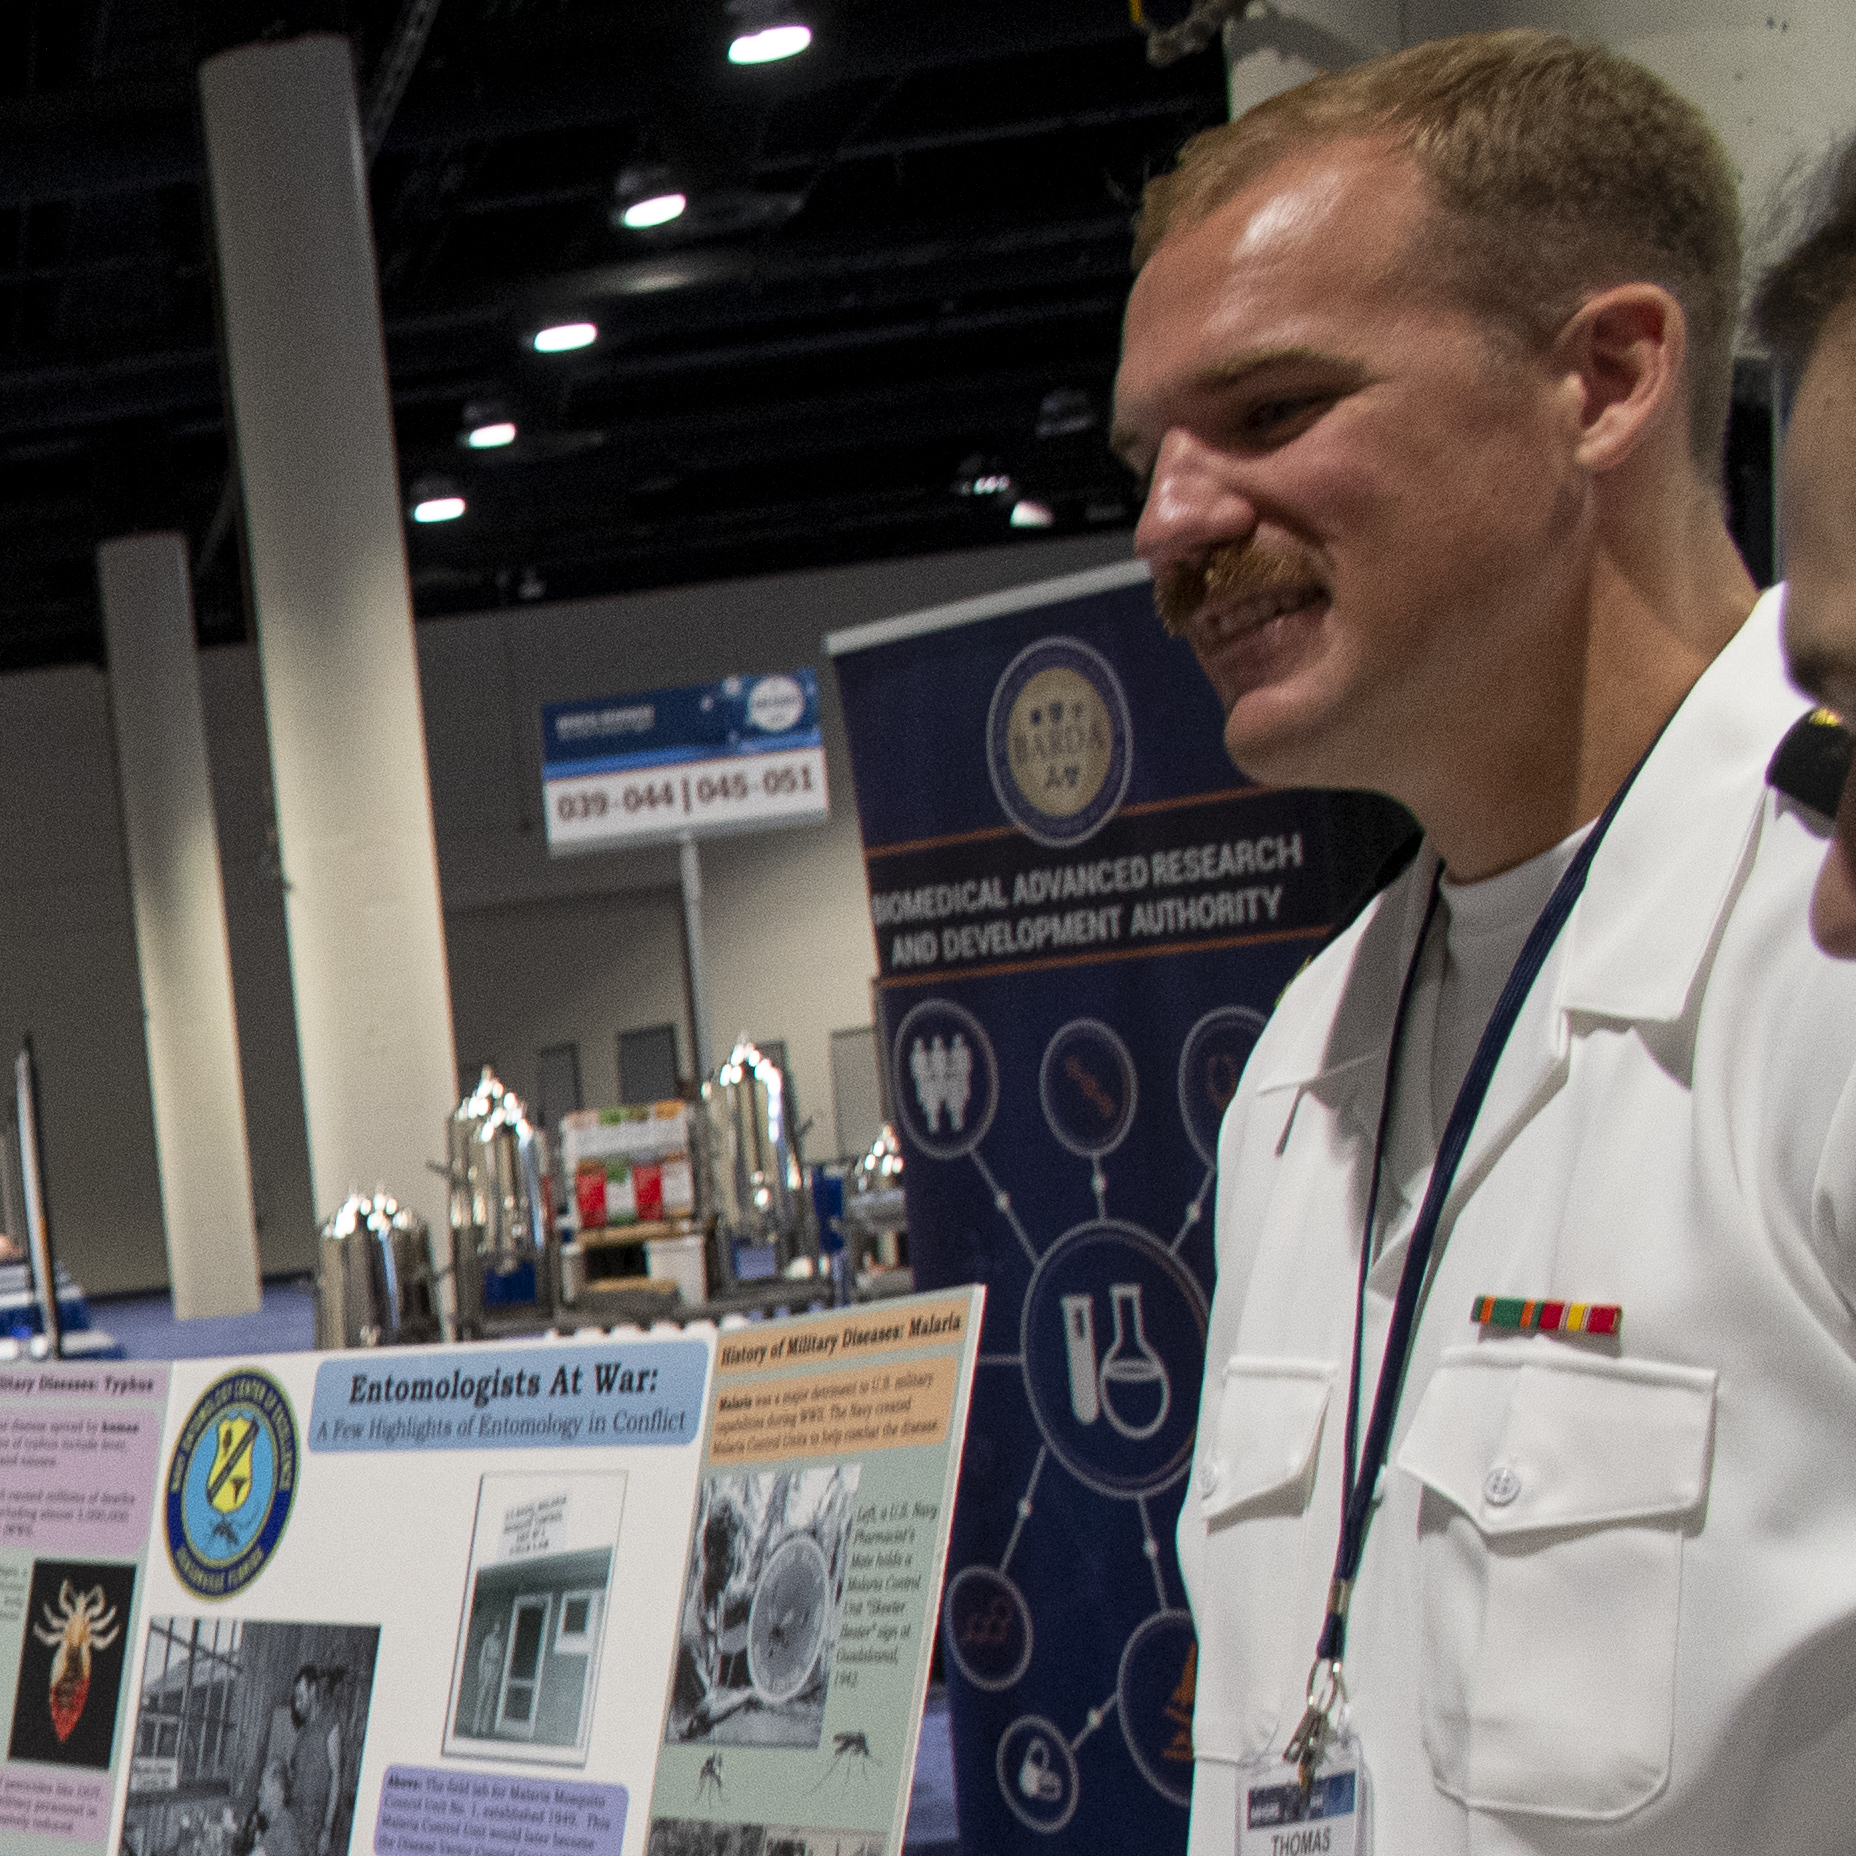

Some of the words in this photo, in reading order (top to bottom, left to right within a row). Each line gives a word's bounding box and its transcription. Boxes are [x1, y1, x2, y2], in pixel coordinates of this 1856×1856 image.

[1012, 855, 1150, 905] ADVANCED
[1152, 831, 1304, 887] RESEARCH
[891, 929, 939, 968] AND
[943, 905, 1122, 961] DEVELOPMENT
[1130, 883, 1284, 936] AUTHORITY
[720, 1345, 767, 1367] History
[769, 1339, 786, 1359] of
[787, 1333, 839, 1356] Military
[841, 1324, 905, 1348] Diseases:
[907, 1312, 961, 1337] Malaria
[104, 1375, 155, 1396] Typhus
[348, 1367, 541, 1408] Entomologists
[549, 1364, 582, 1397] At
[594, 1361, 660, 1395] War:
[315, 1421, 328, 1442] A
[332, 1418, 363, 1441] Few
[368, 1414, 452, 1447] Highlights
[457, 1413, 475, 1438] of
[478, 1409, 584, 1441] Entomology
[588, 1411, 607, 1434] in
[612, 1406, 687, 1435] Conflict
